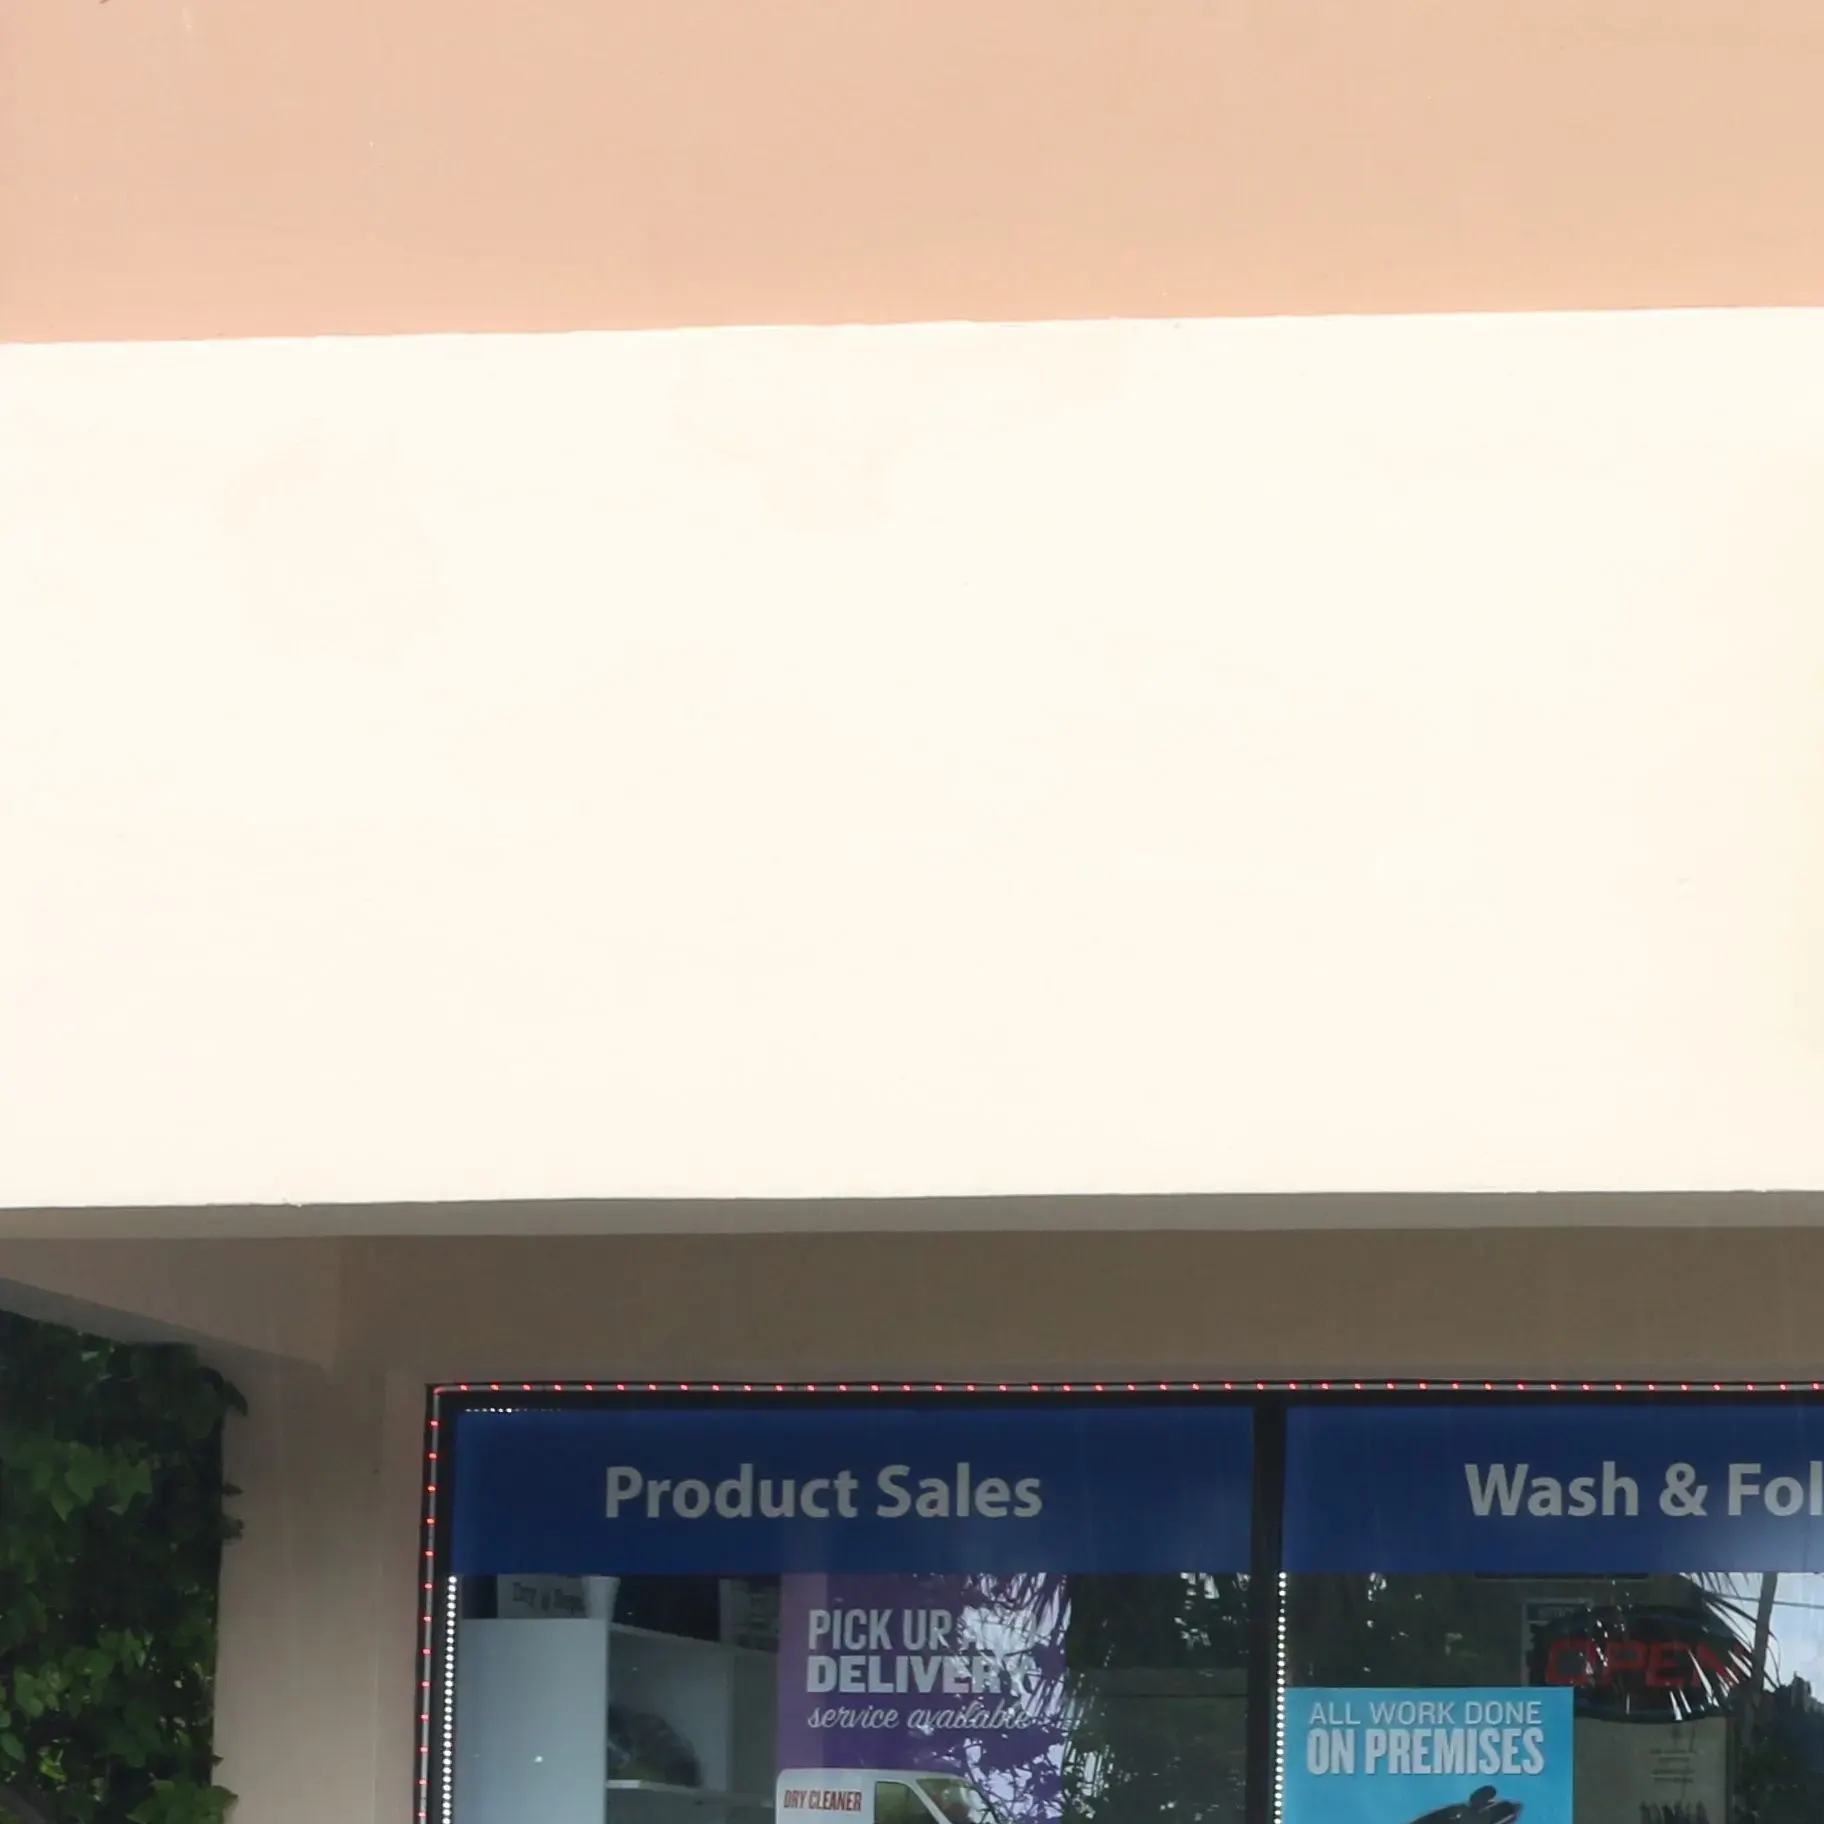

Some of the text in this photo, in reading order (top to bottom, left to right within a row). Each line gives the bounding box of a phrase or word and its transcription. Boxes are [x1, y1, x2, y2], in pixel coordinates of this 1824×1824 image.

[605, 1462, 1042, 1519] Product Sales
[1464, 1461, 1639, 1516] Wash
[1659, 1462, 1707, 1517] &
[807, 1609, 892, 1651] PICK
[902, 1609, 952, 1651] UP
[1545, 1637, 1753, 1688] OPEN
[807, 1699, 1030, 1730] service available
[1309, 1702, 1542, 1725] ALL WORK DONE
[1306, 1730, 1545, 1776] ON PREMISES
[784, 1790, 862, 1812] DRY CLEANER
